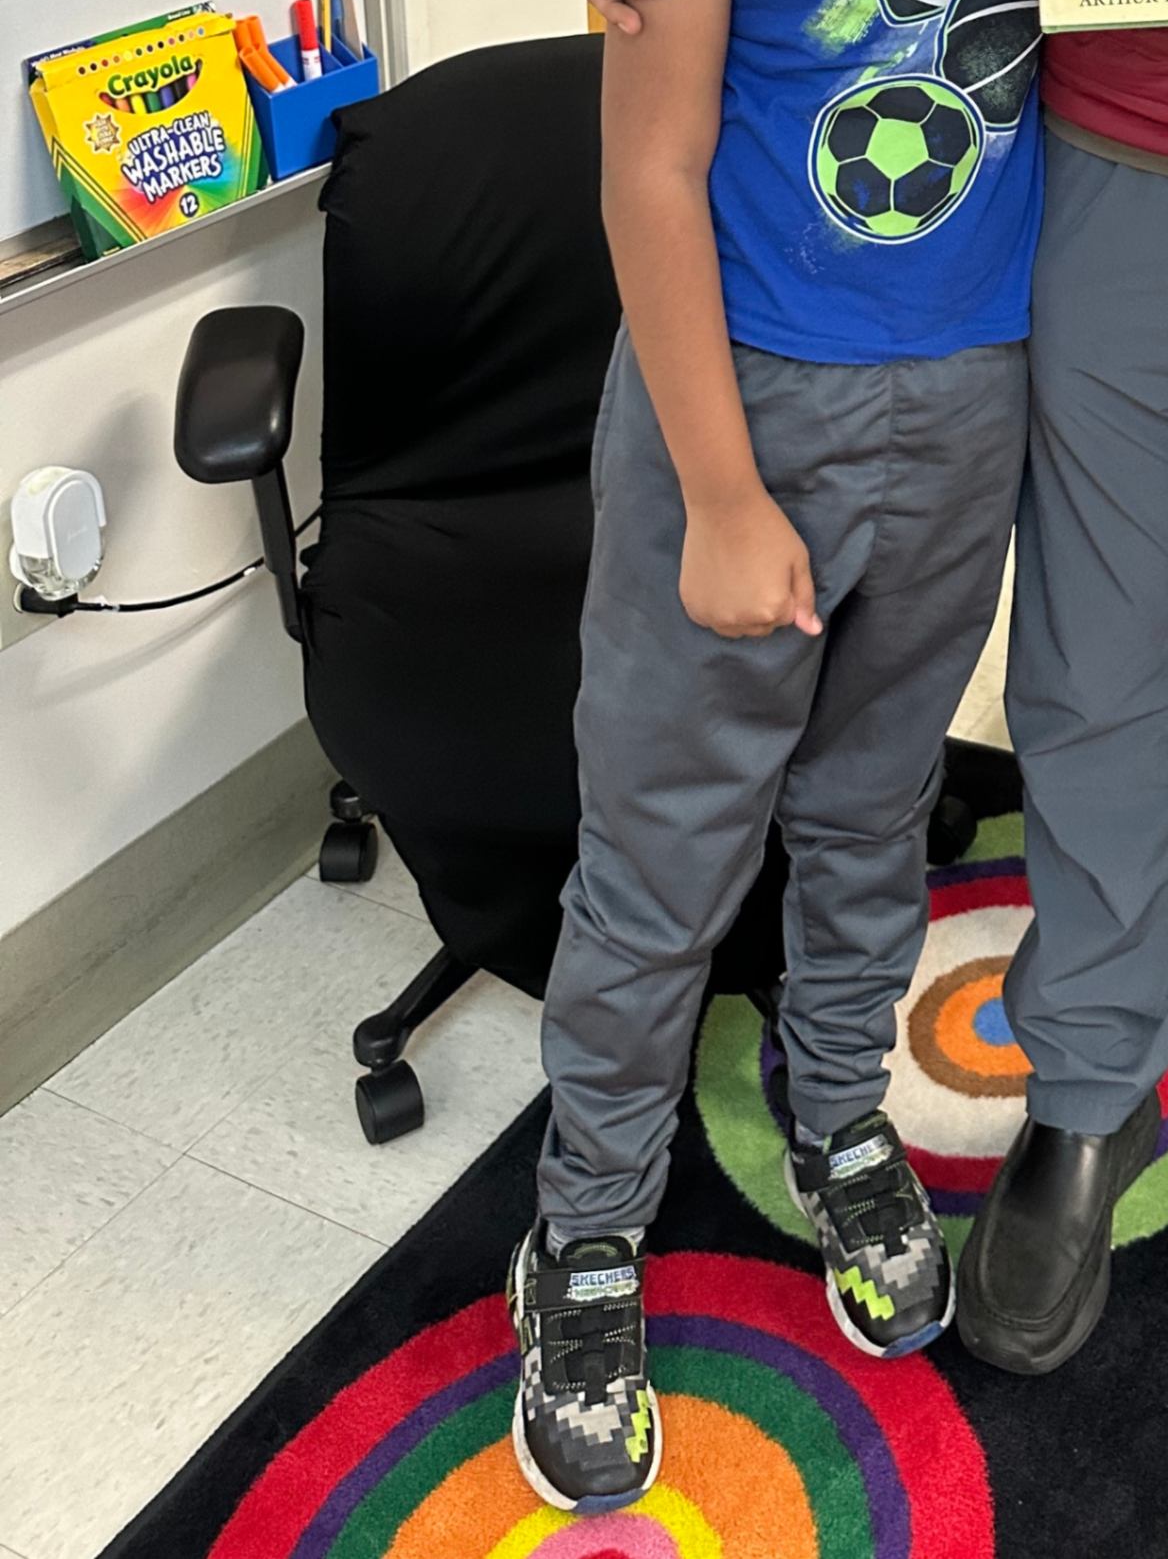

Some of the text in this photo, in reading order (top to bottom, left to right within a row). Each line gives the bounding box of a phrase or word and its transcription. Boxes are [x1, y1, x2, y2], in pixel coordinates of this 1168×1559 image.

[107, 56, 193, 96] Crayola
[128, 111, 211, 156] ULTRA-CLEAN
[121, 128, 225, 185] WASHABLE
[142, 153, 222, 203] MARKERS
[181, 195, 199, 215] 12
[571, 1267, 634, 1288] SKECHERS
